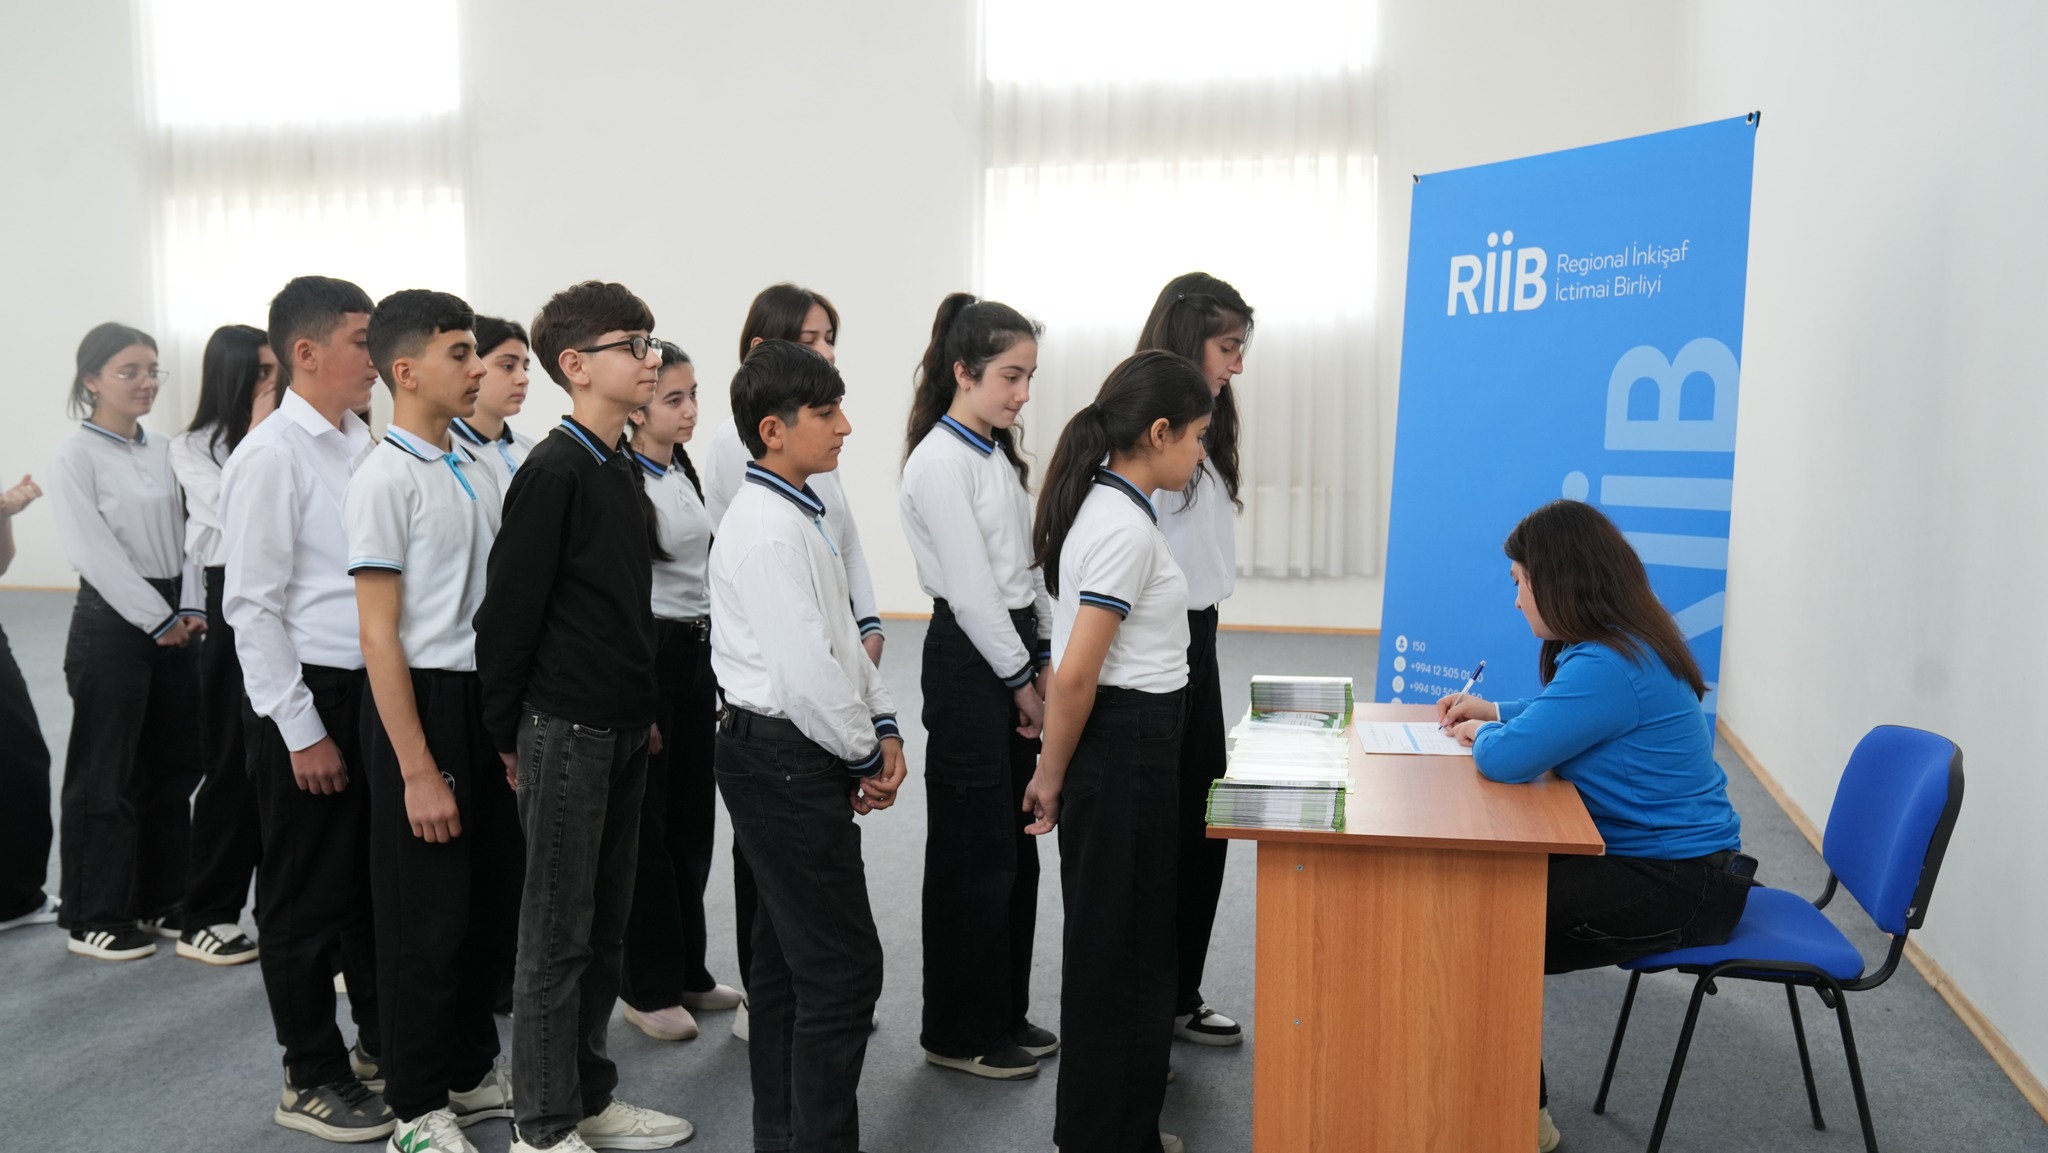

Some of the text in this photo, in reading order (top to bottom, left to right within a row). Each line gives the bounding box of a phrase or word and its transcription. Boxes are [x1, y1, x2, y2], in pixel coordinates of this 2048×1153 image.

[1556, 238, 1691, 277] Regional İnkişaf
[1554, 273, 1662, 302] İctimai Birliyi
[1412, 641, 1426, 652] 150
[1411, 662, 1431, 673] +994
[1433, 665, 1441, 676] 12
[1443, 667, 1459, 679] 505
[1409, 682, 1429, 693] +994
[1431, 685, 1441, 696] 50
